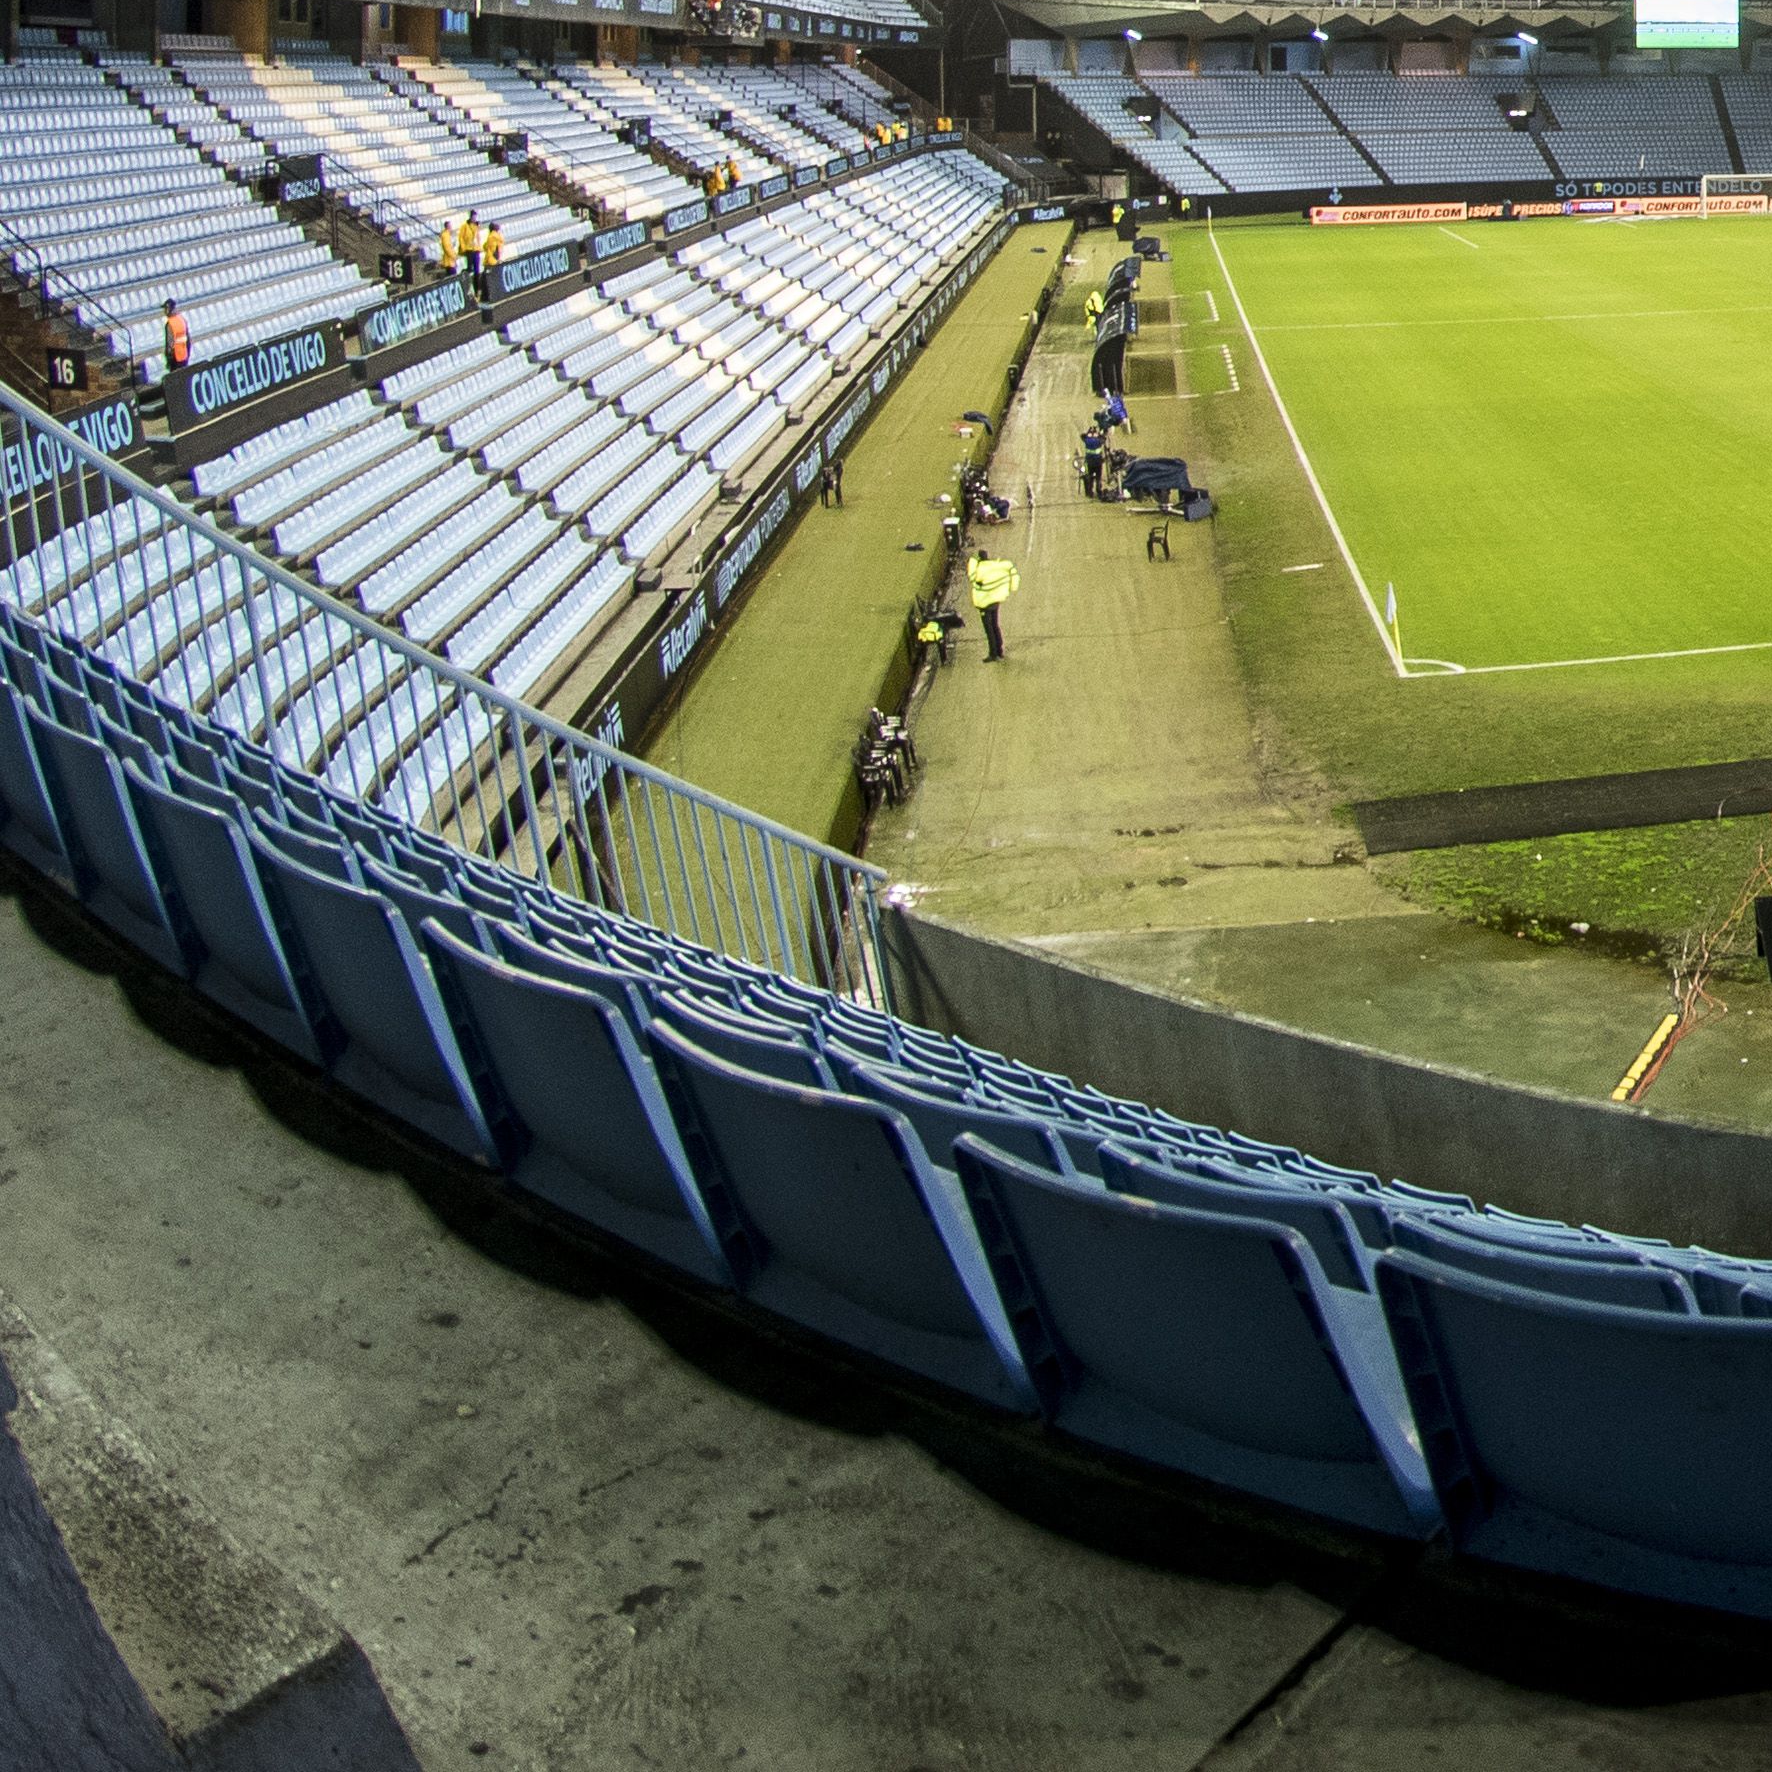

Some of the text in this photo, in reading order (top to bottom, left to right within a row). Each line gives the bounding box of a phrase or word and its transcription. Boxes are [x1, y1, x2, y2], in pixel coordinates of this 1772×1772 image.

[1555, 181, 1577, 197] SÓ
[54, 357, 75, 384] 16
[191, 330, 327, 415] CONCELLO DE VIGO
